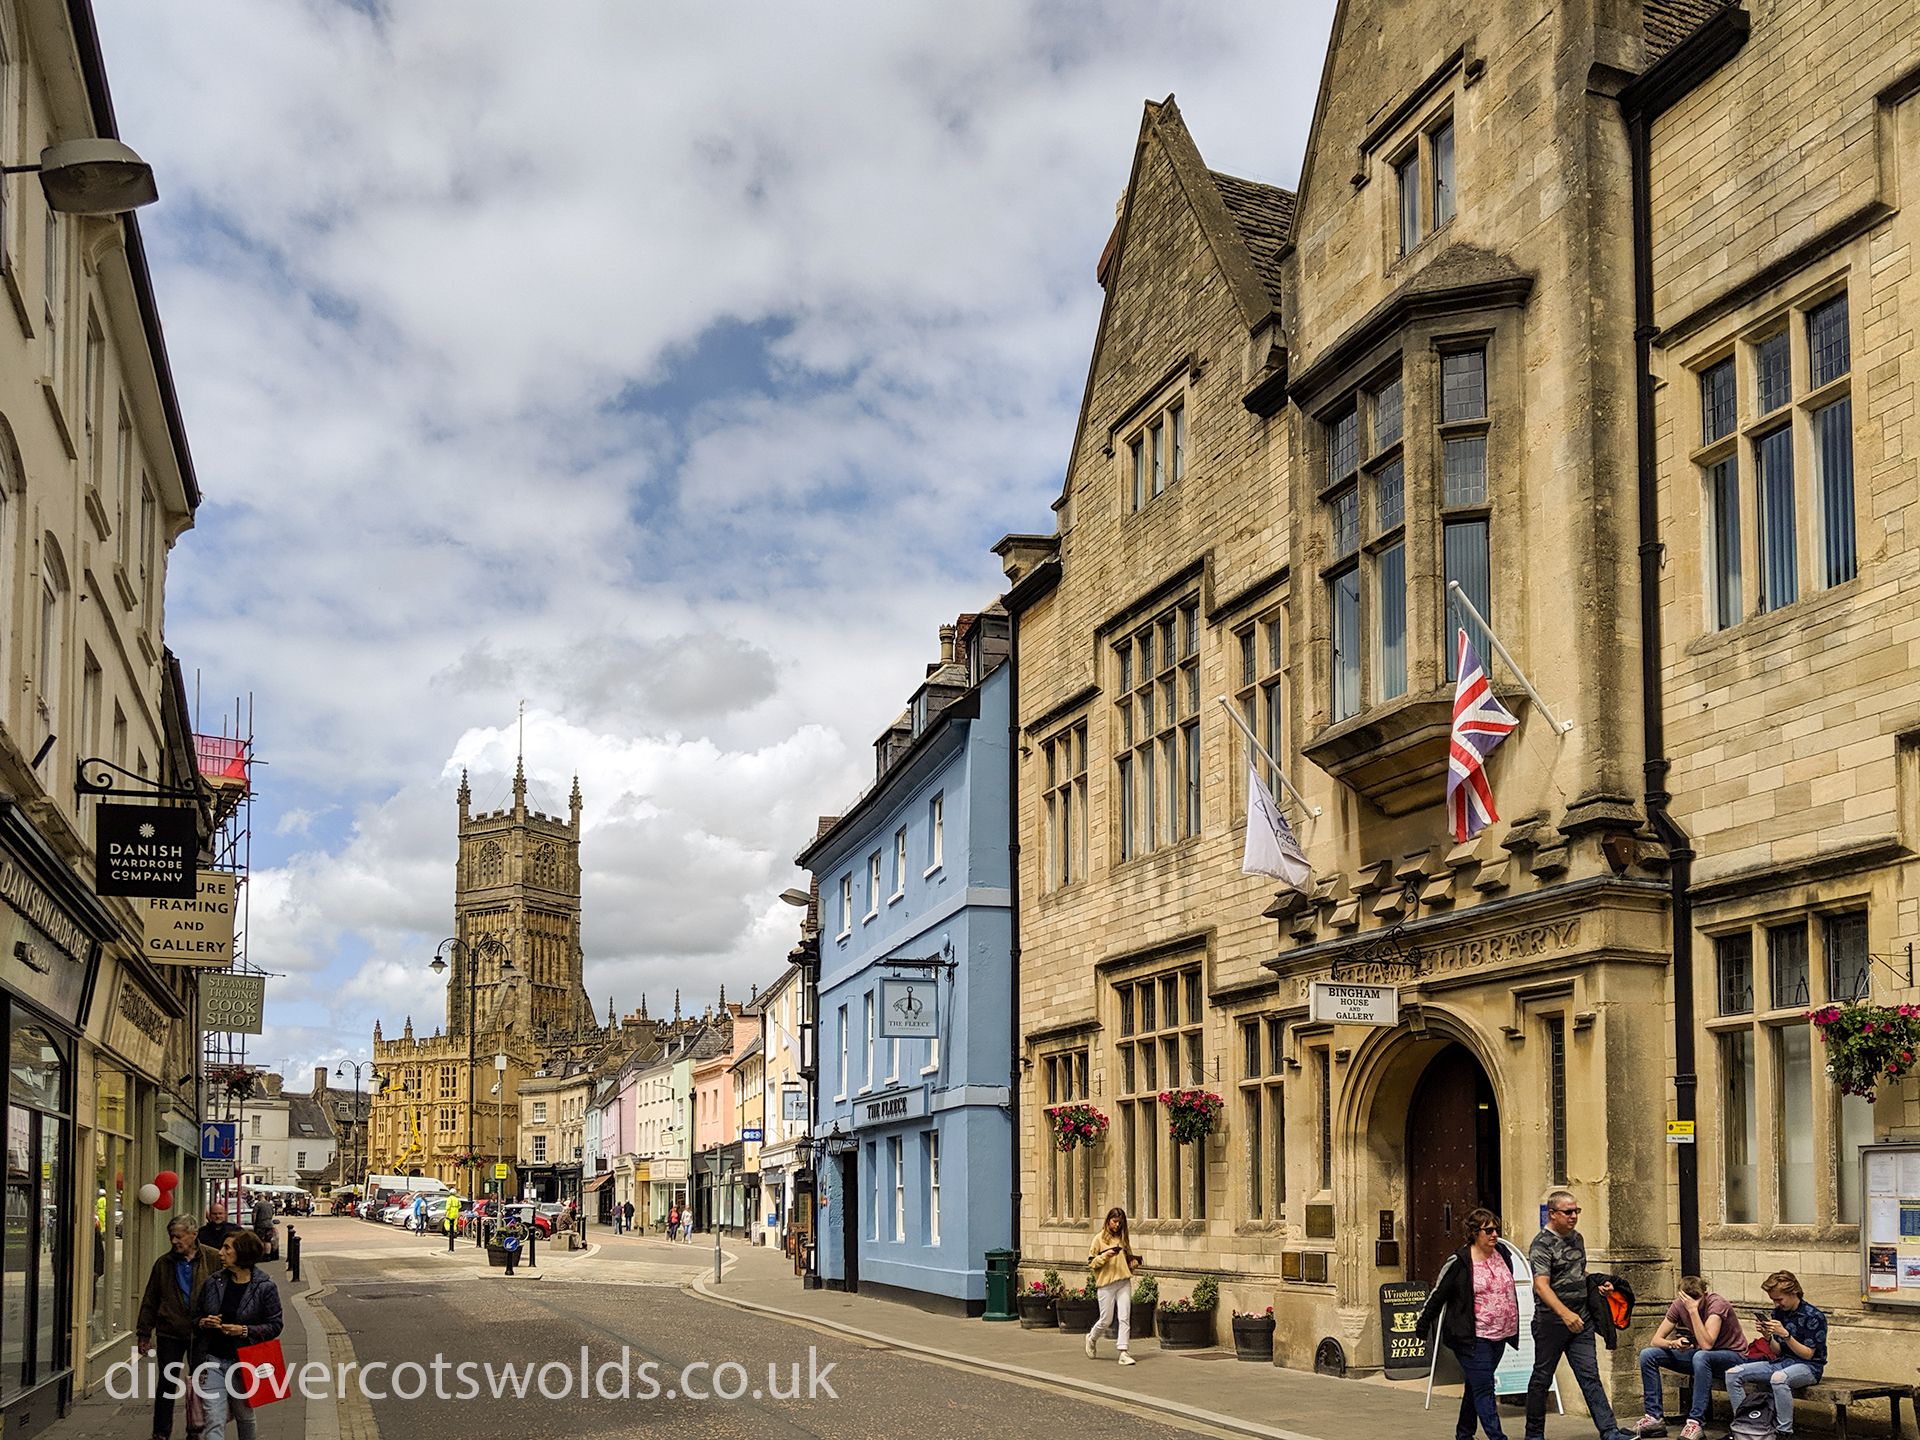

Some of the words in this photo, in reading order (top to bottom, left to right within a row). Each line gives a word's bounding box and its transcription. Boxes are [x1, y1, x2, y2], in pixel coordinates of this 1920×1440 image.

[109, 843, 182, 858] DANISH
[110, 858, 183, 869] WARDROBE
[111, 870, 183, 883] COMPANY
[150, 898, 229, 914] FRAMING
[173, 920, 204, 931] AND
[150, 938, 227, 953] GALLERY
[208, 978, 260, 990] STEAMER
[208, 987, 259, 1000] TRADING
[1328, 987, 1381, 999] BINGHAM
[207, 998, 257, 1014] COOK
[1340, 998, 1370, 1007] HOUSE
[206, 1011, 257, 1028] SHOP
[1335, 1011, 1375, 1021] GALLERY
[904, 1020, 930, 1028] FLEECE
[866, 1103, 881, 1120] THE
[881, 1096, 908, 1118] FLEECE
[1383, 1289, 1426, 1299] Winstones
[1390, 1338, 1425, 1349] SOLD
[1391, 1347, 1426, 1358] HERE
